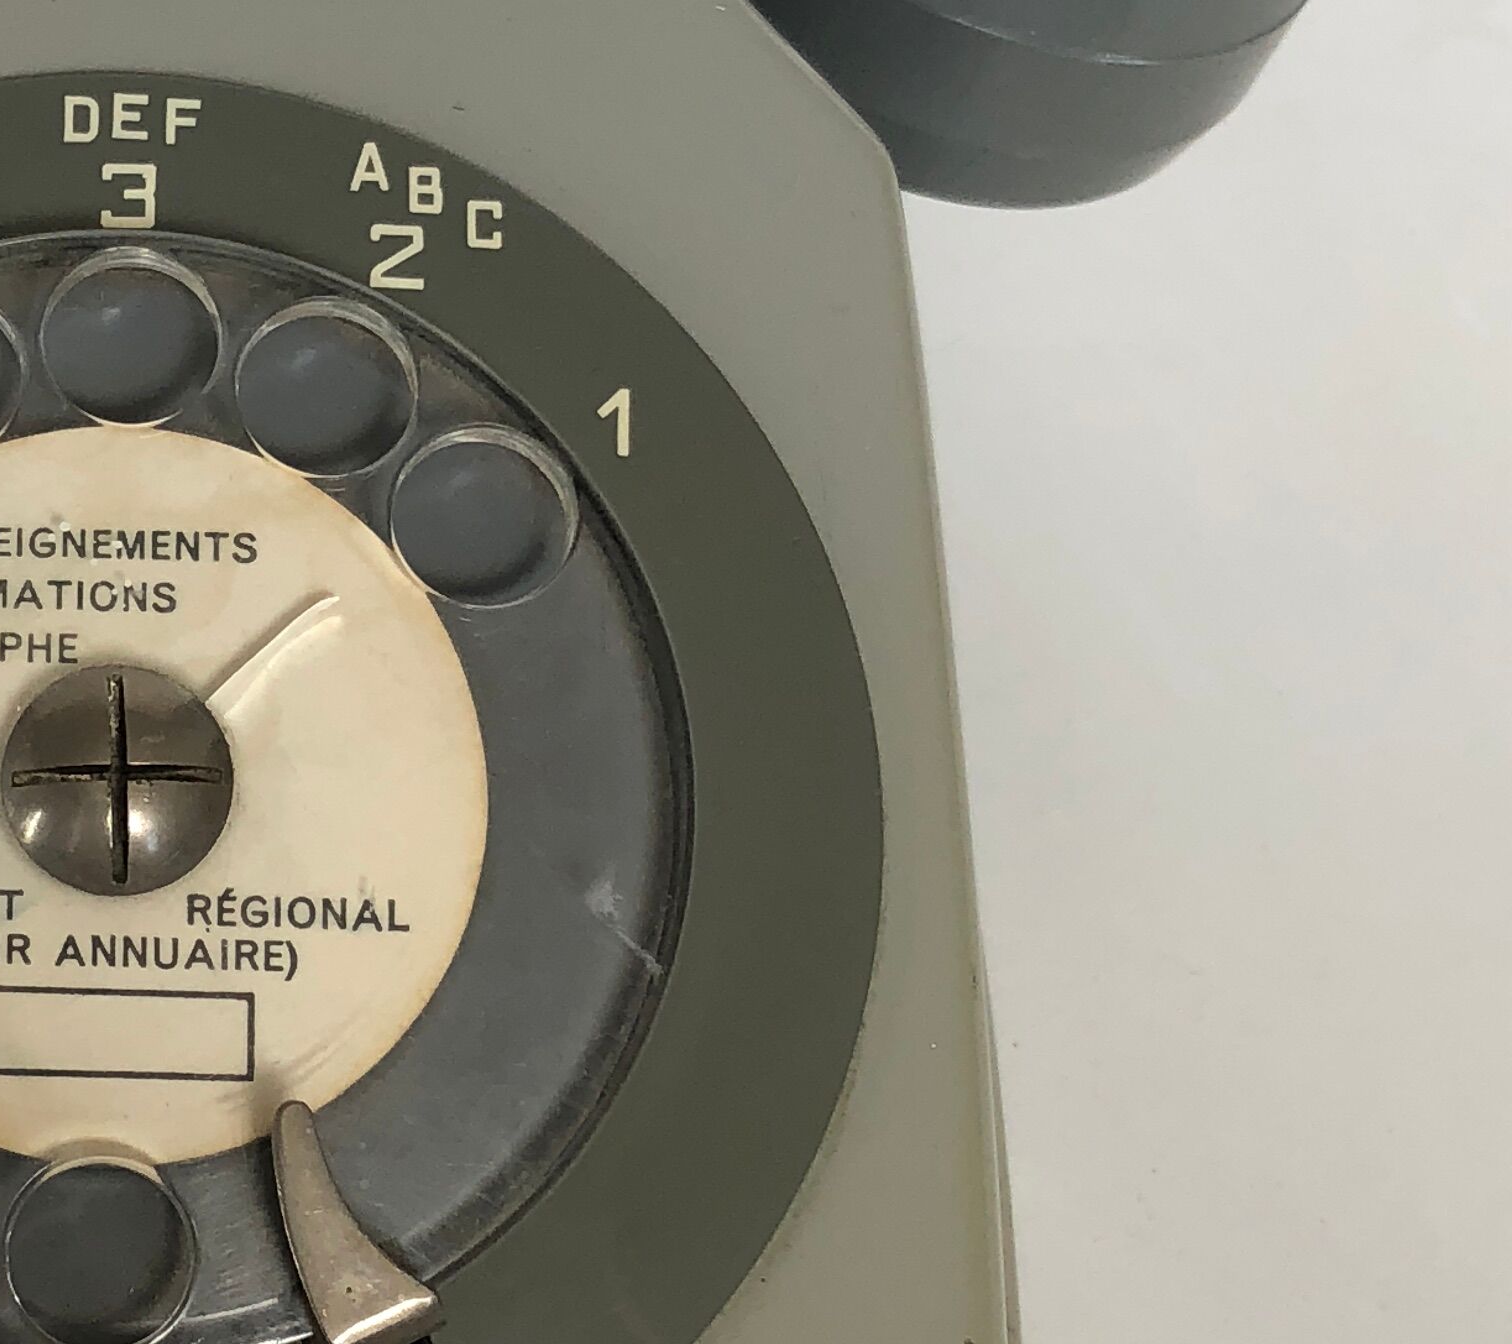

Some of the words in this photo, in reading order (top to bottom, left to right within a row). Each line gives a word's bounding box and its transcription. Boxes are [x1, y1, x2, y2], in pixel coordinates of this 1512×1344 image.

[100, 163, 158, 229] 3
[369, 223, 425, 290] 2
[596, 388, 631, 457] 1
[186, 887, 411, 933] RÉGIONAL
[54, 934, 299, 982] ANNUAIRE)
